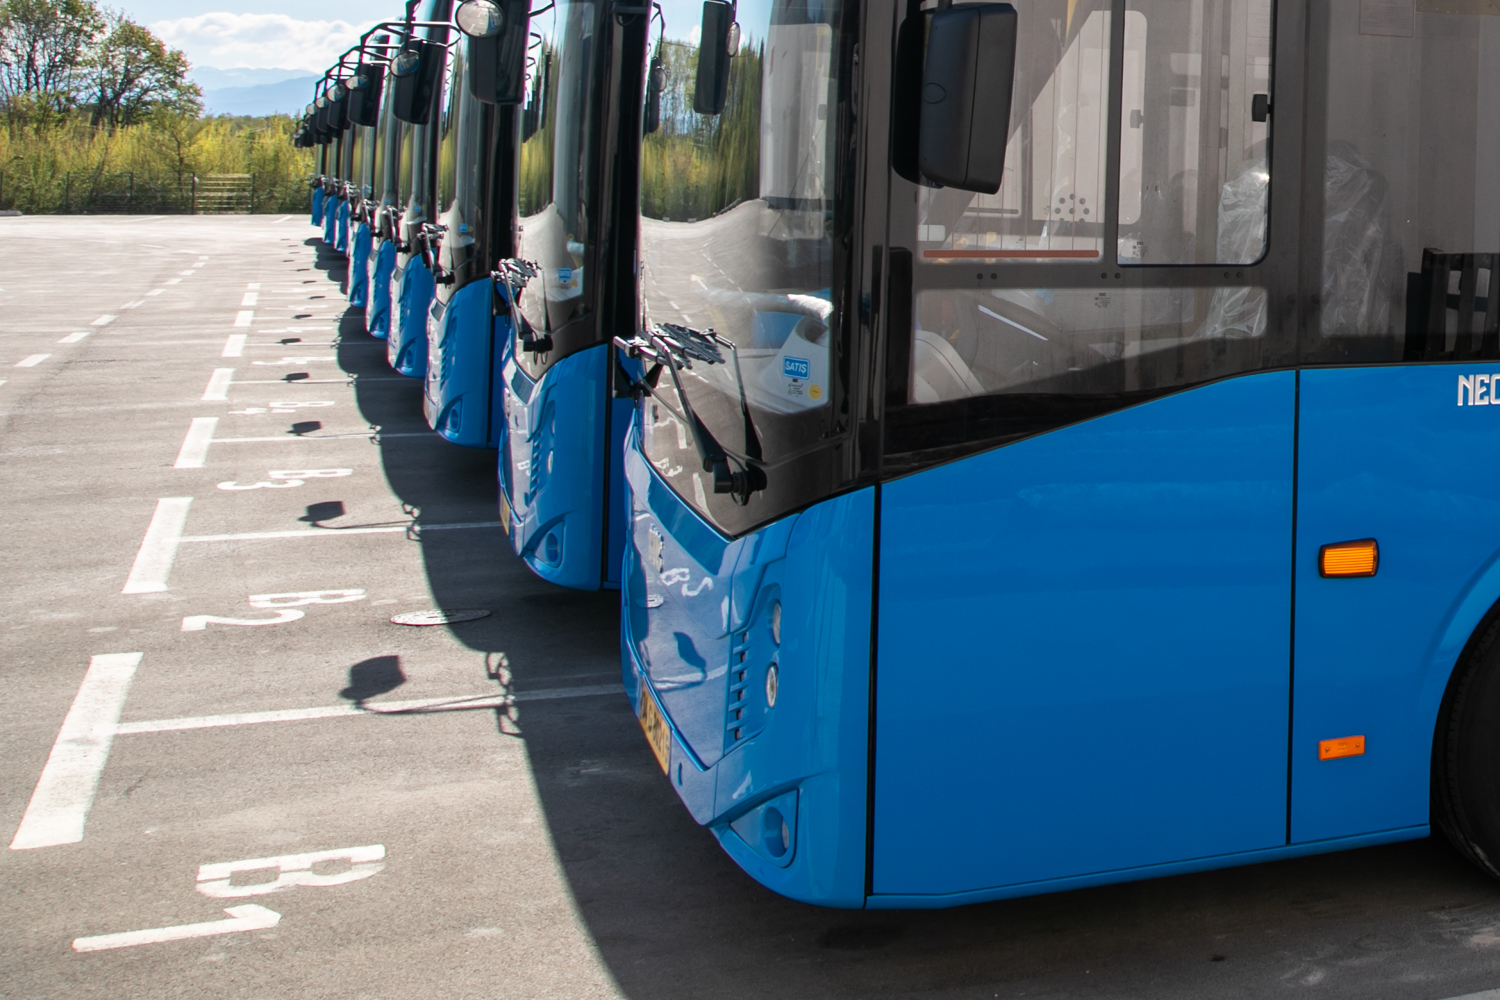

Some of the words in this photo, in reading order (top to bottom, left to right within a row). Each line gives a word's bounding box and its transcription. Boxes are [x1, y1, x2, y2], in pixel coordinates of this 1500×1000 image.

[217, 468, 354, 491] B3
[181, 588, 367, 632] B2
[73, 844, 385, 952] B1
